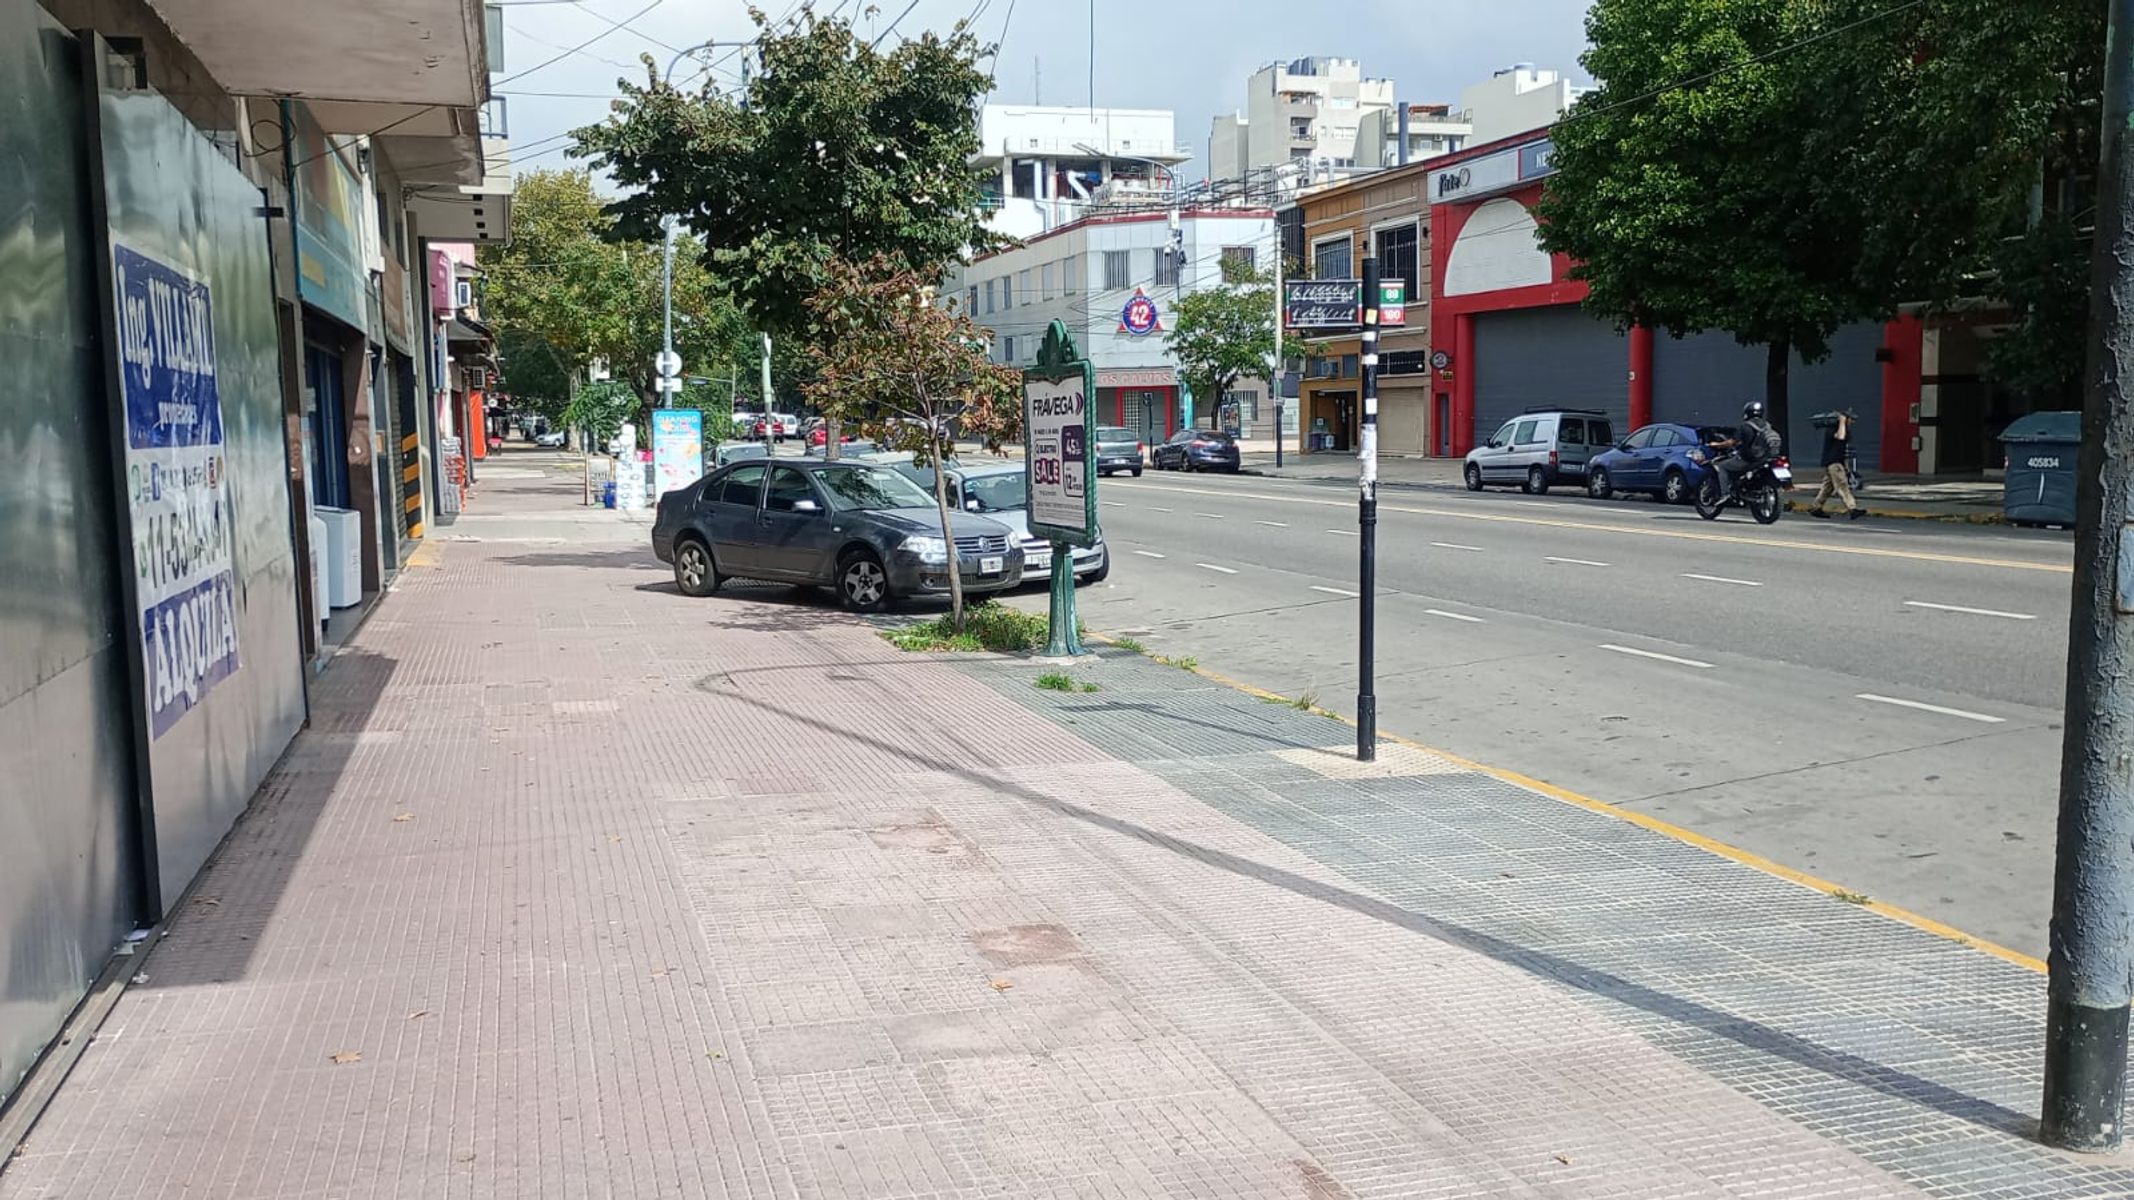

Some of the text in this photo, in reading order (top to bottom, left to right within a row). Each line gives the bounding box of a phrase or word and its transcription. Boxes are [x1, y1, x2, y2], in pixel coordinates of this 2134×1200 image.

[1130, 304, 1149, 326] 42
[1033, 392, 1074, 417] FRÁVEGA
[1035, 459, 1059, 482] SALE
[153, 584, 237, 712] ALQUILA
